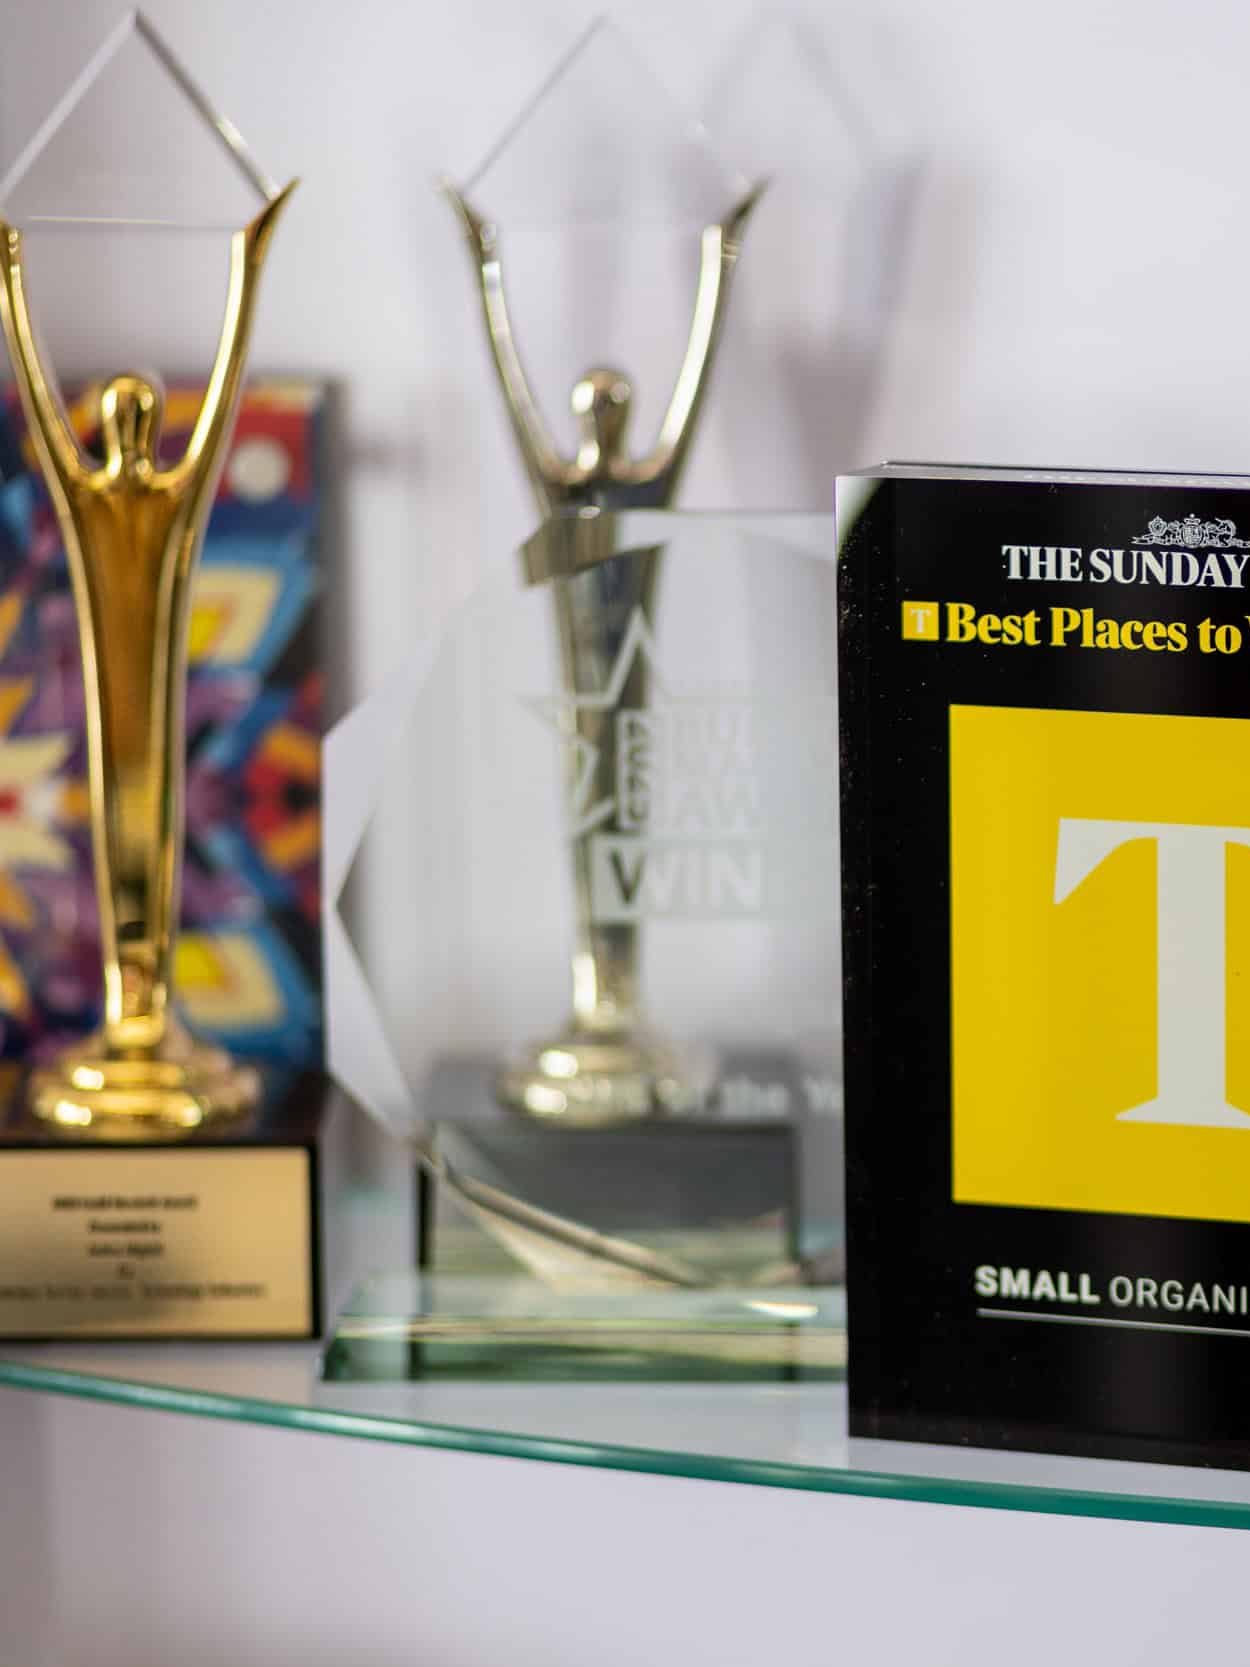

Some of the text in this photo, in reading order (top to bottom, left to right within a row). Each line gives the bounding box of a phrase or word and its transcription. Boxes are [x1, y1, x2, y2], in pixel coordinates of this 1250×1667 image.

[1002, 545, 1081, 582] THE
[1089, 548, 1250, 590] SUNDAY
[945, 602, 1041, 646] Best
[1050, 606, 1188, 652] Places
[1199, 617, 1242, 654] to
[975, 1264, 1100, 1303] SMALL
